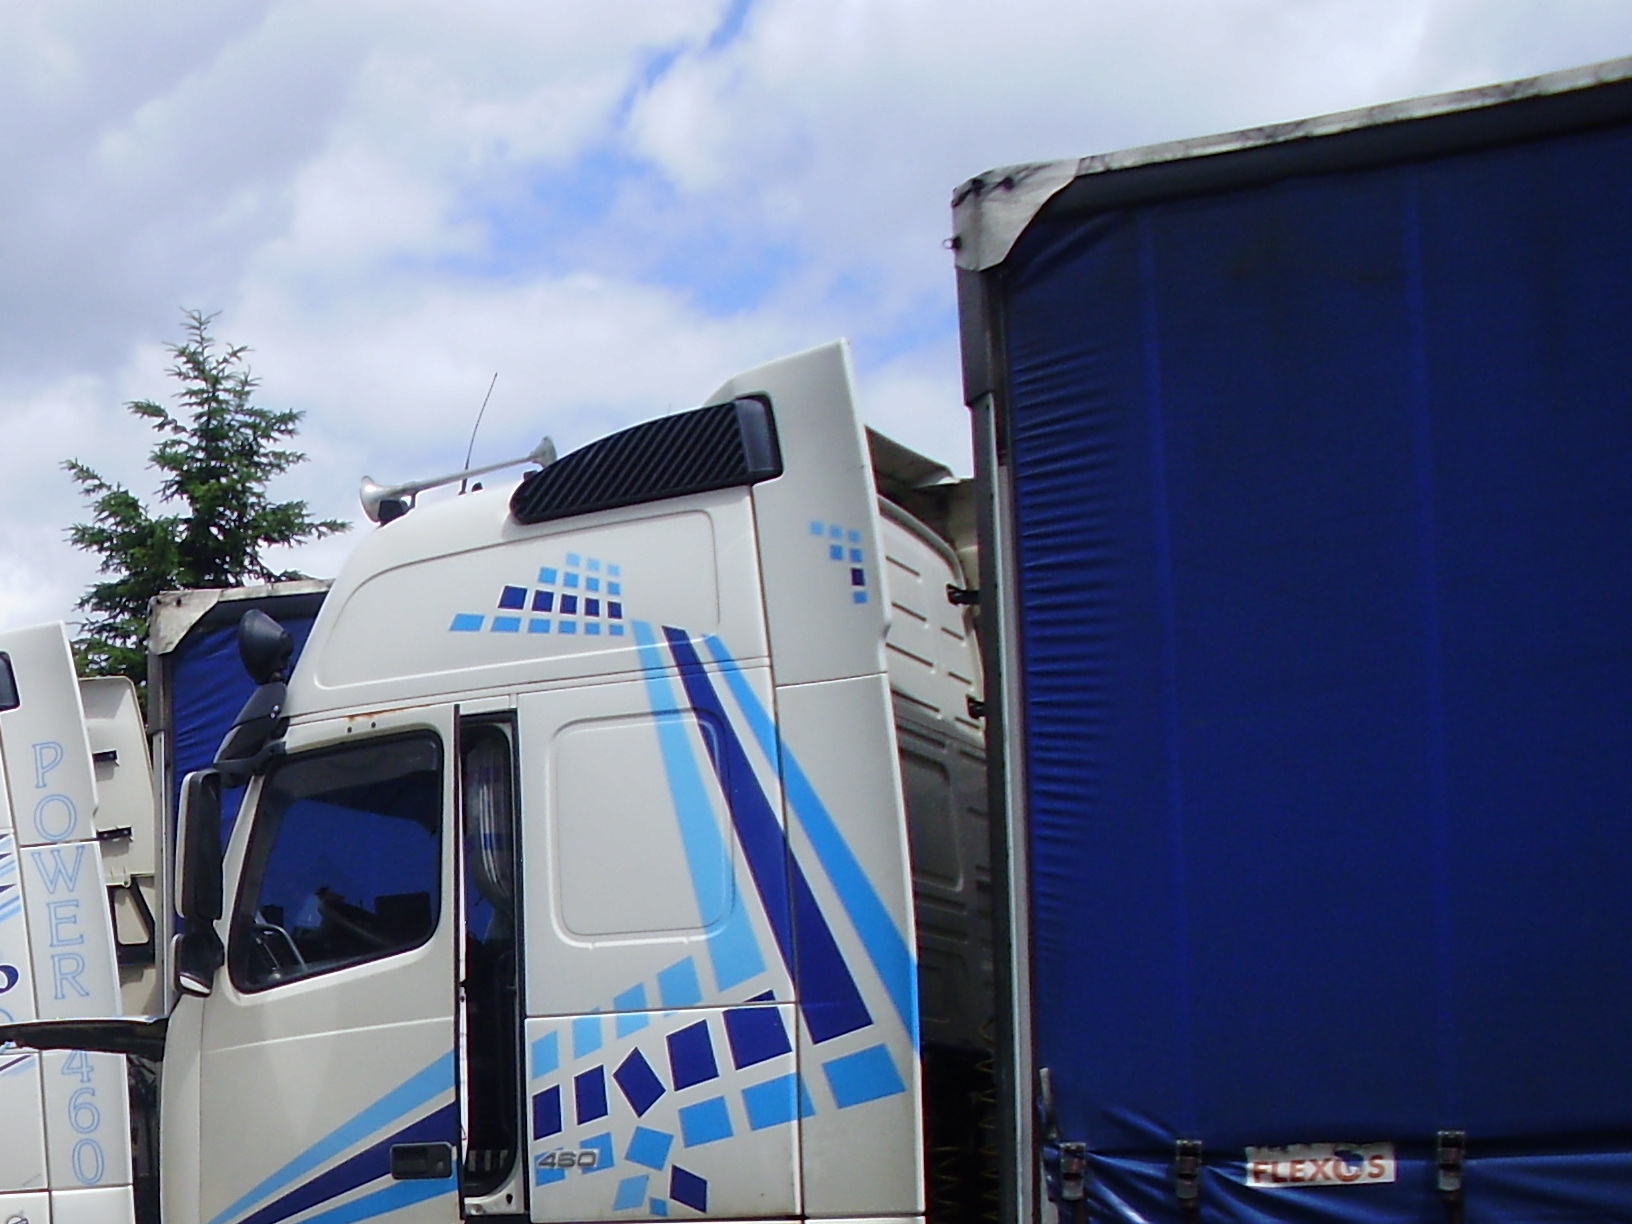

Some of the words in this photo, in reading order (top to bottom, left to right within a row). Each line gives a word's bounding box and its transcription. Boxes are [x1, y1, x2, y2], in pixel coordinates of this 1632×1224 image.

[31, 741, 90, 1000] POWER
[62, 1050, 105, 1185] 460
[538, 1150, 597, 1168] 460
